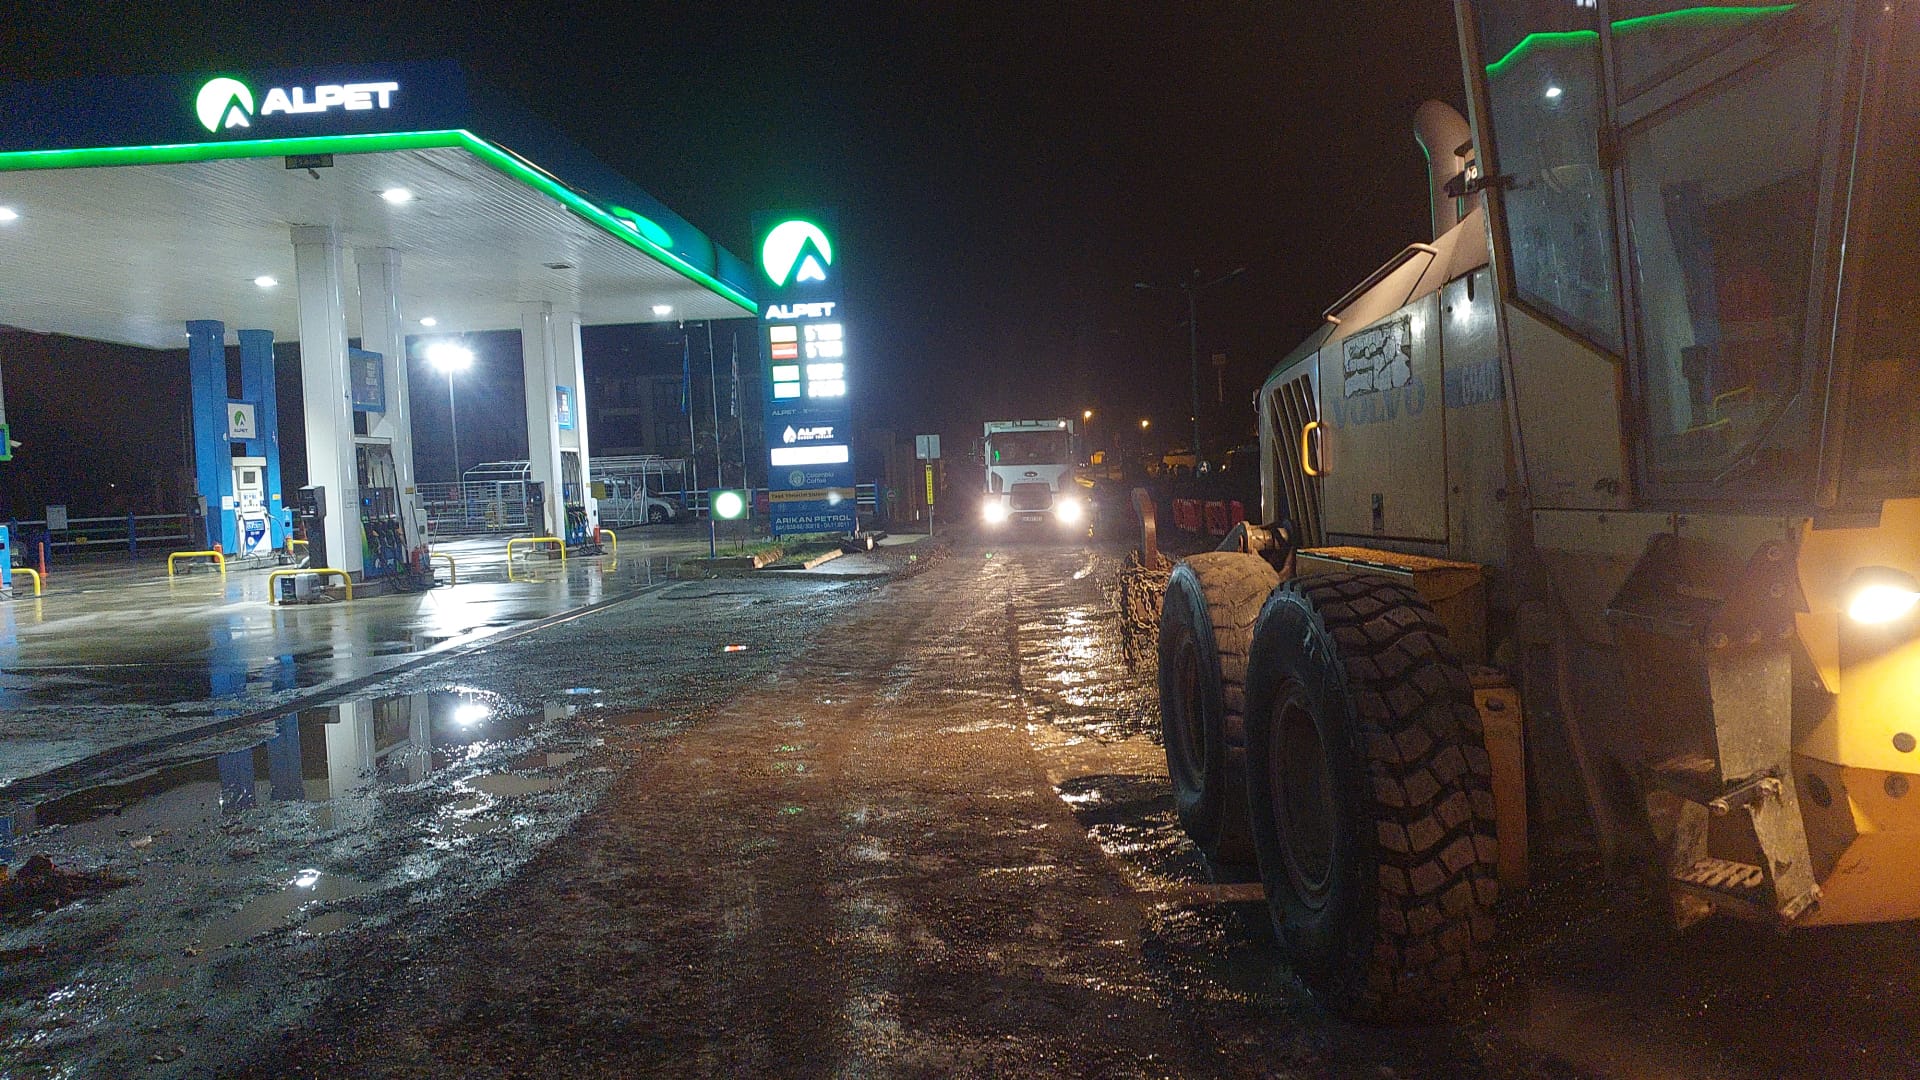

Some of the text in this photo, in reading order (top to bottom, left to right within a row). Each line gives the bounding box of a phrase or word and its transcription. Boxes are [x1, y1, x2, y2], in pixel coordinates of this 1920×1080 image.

[261, 82, 398, 115] ALPET
[765, 302, 835, 319] ALPET
[1330, 376, 1426, 429] VOLVO
[797, 427, 833, 436] ALPET
[776, 514, 851, 524] ARIKAN PETROL
